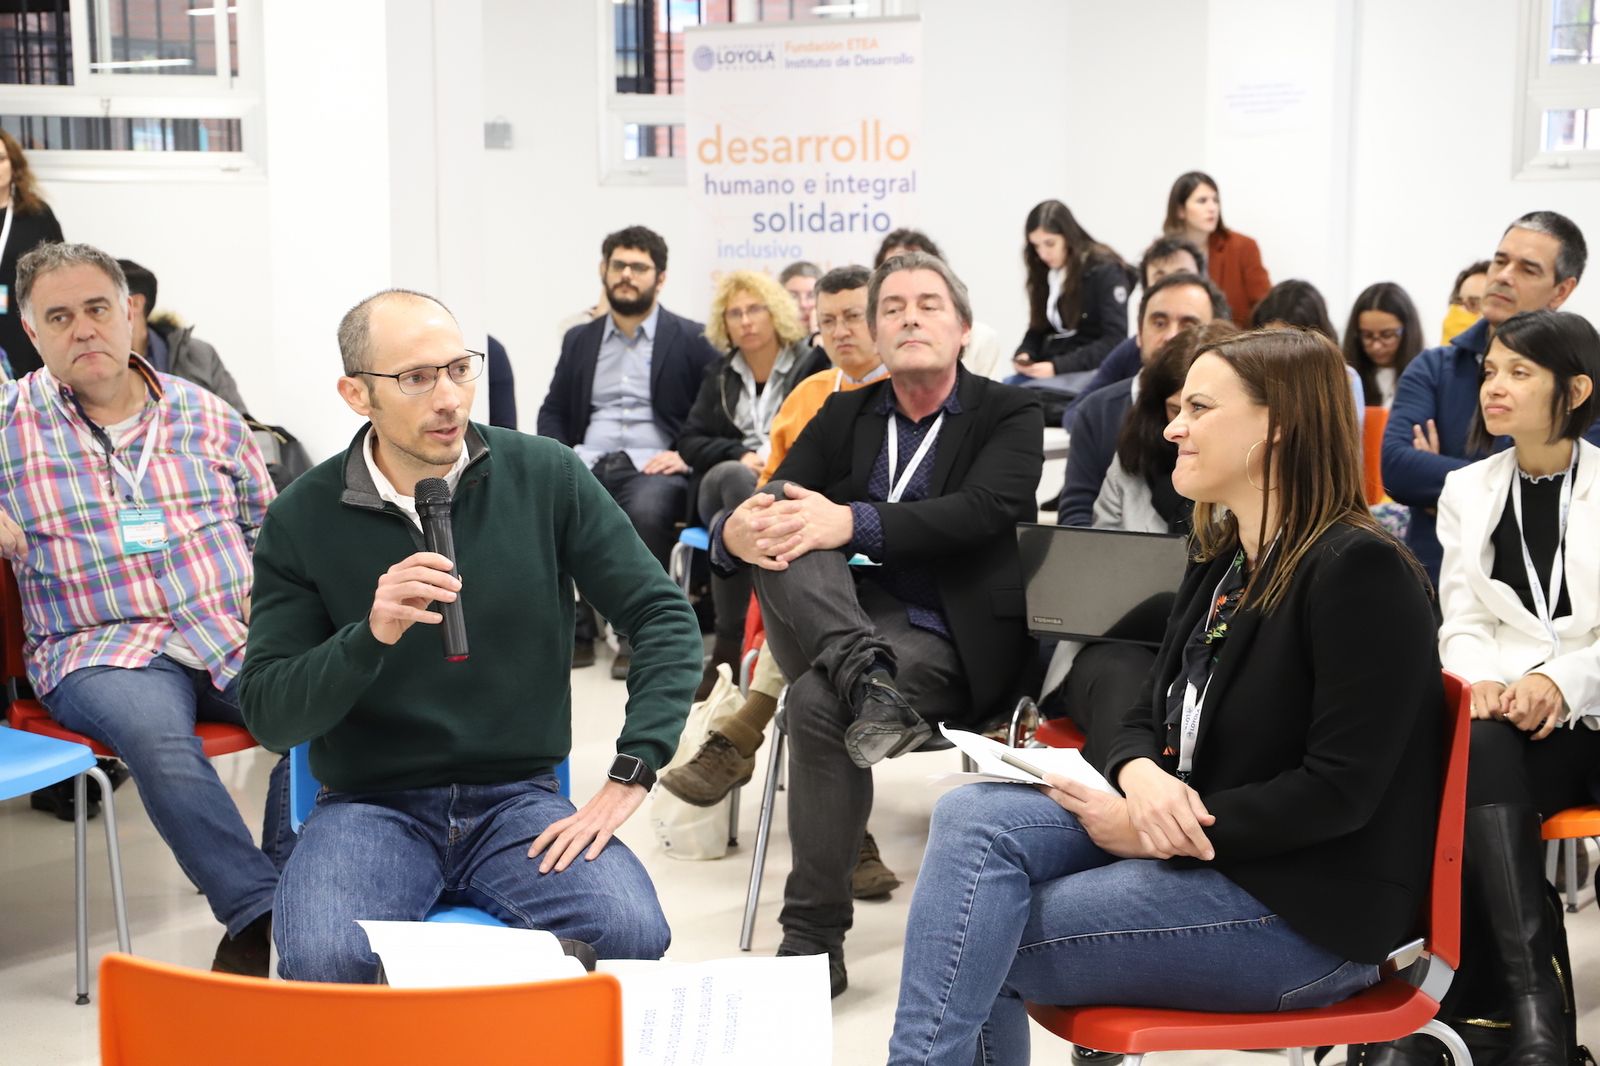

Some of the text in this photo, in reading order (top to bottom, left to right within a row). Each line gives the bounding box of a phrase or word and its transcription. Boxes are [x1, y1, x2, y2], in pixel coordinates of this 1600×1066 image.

[717, 49, 775, 65] LOYOLA
[784, 56, 832, 69] Instituto
[835, 55, 850, 67] de
[854, 51, 915, 66] Desarrollo
[697, 119, 911, 165] desarrollo
[704, 171, 917, 199] humano e integral
[752, 201, 891, 233] solidario
[717, 239, 803, 260] inclusivo
[1034, 616, 1062, 624] TOSHIBA
